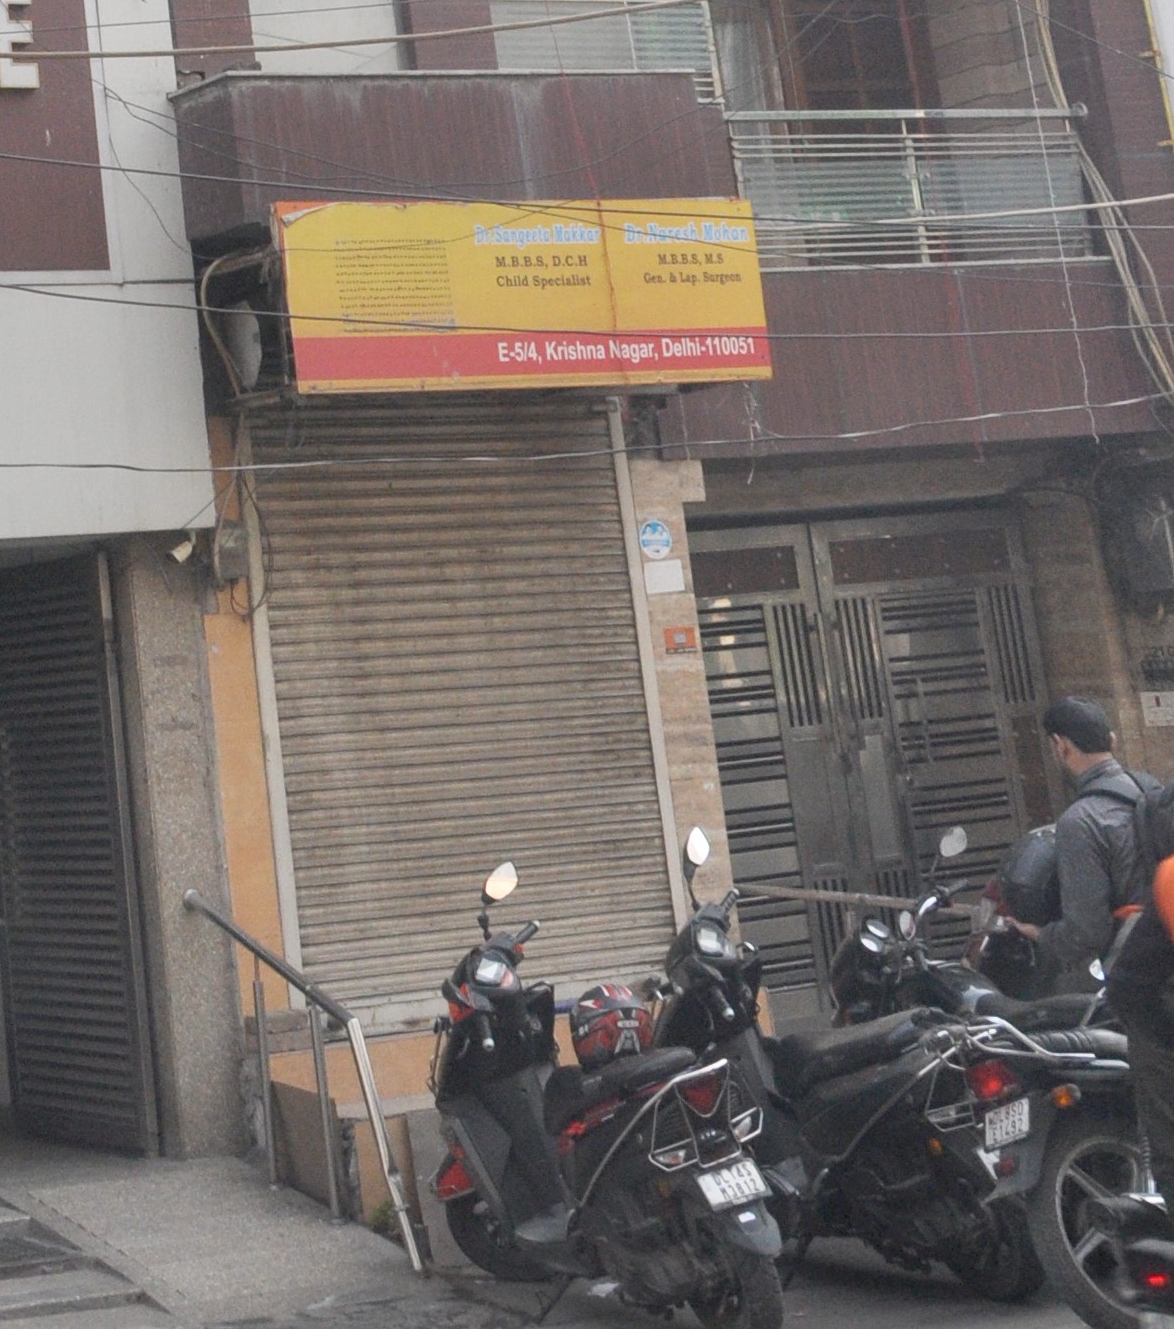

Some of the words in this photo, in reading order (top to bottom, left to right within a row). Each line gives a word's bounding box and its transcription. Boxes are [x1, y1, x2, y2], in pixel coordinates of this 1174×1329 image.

[702, 221, 749, 242] Mohan
[496, 275, 529, 287] Child
[532, 274, 591, 290] Specialist
[669, 272, 677, 283] &
[703, 272, 742, 285] Surgeon
[498, 342, 542, 365] E-5/4,
[546, 340, 605, 361] Krishna
[610, 340, 658, 363] Nagar,
[662, 336, 755, 358] Delhi-110051
